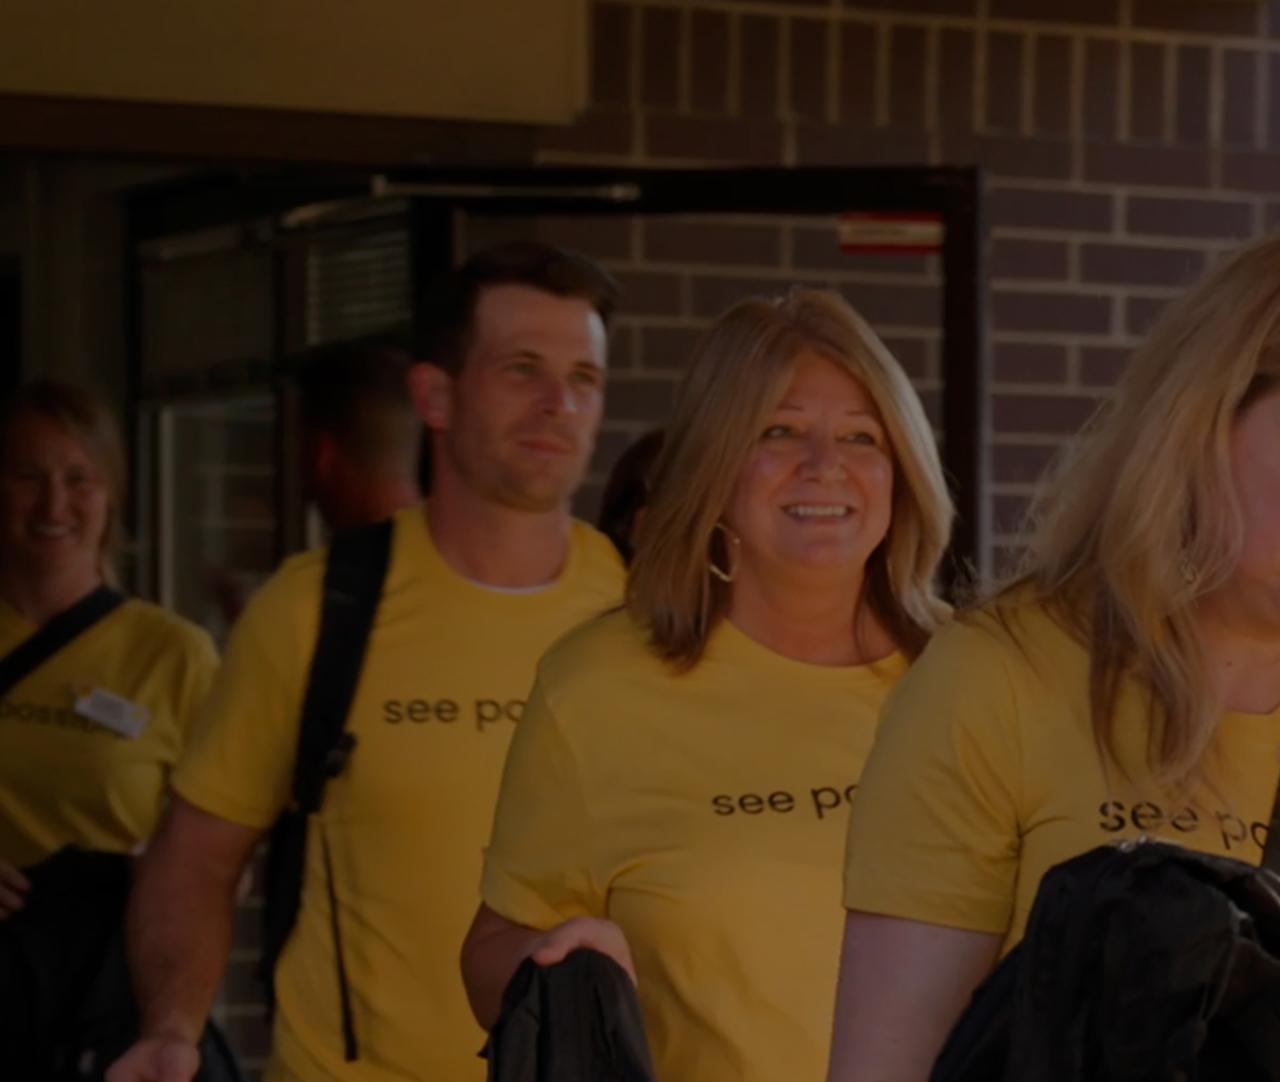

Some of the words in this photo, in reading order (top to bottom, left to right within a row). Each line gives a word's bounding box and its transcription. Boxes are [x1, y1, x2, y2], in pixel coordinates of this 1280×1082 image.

[384, 698, 459, 725] see
[712, 790, 795, 816] see
[1100, 802, 1198, 832] see
